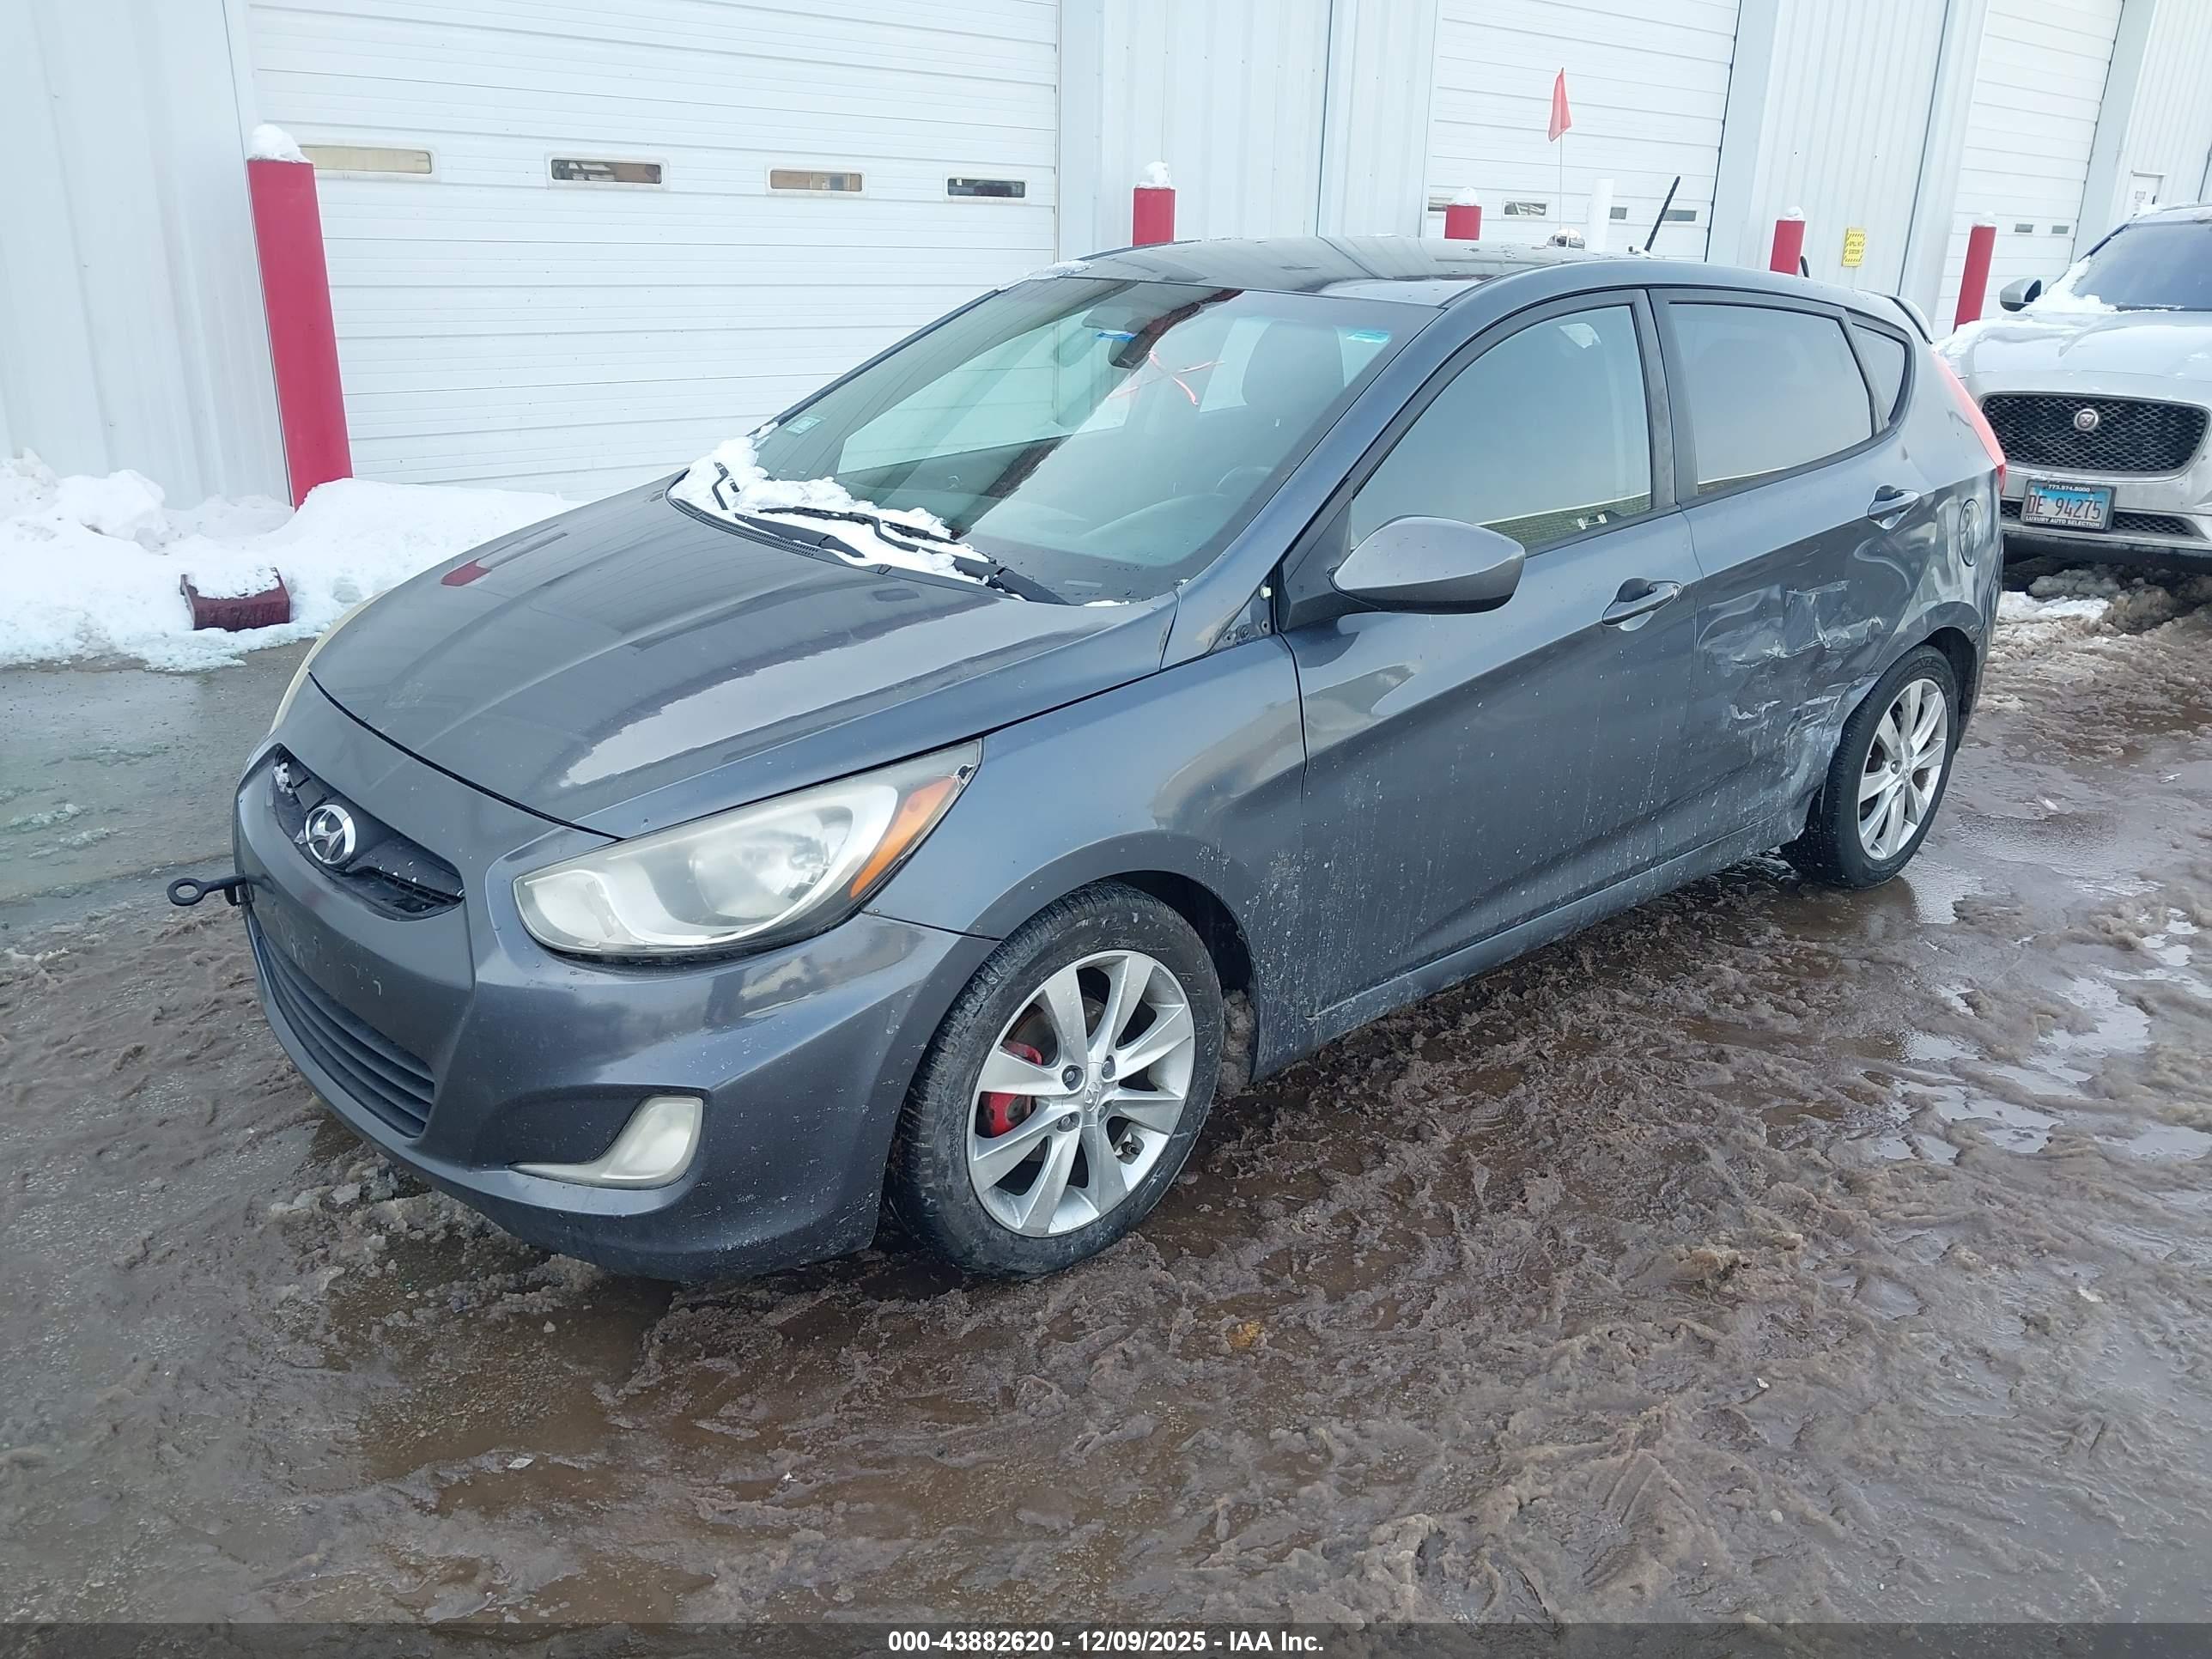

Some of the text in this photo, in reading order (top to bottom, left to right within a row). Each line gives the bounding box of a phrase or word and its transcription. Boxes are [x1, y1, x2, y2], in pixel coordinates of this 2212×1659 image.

[2026, 495, 2103, 520] DE 94275
[2067, 519, 2101, 527] SELECTION
